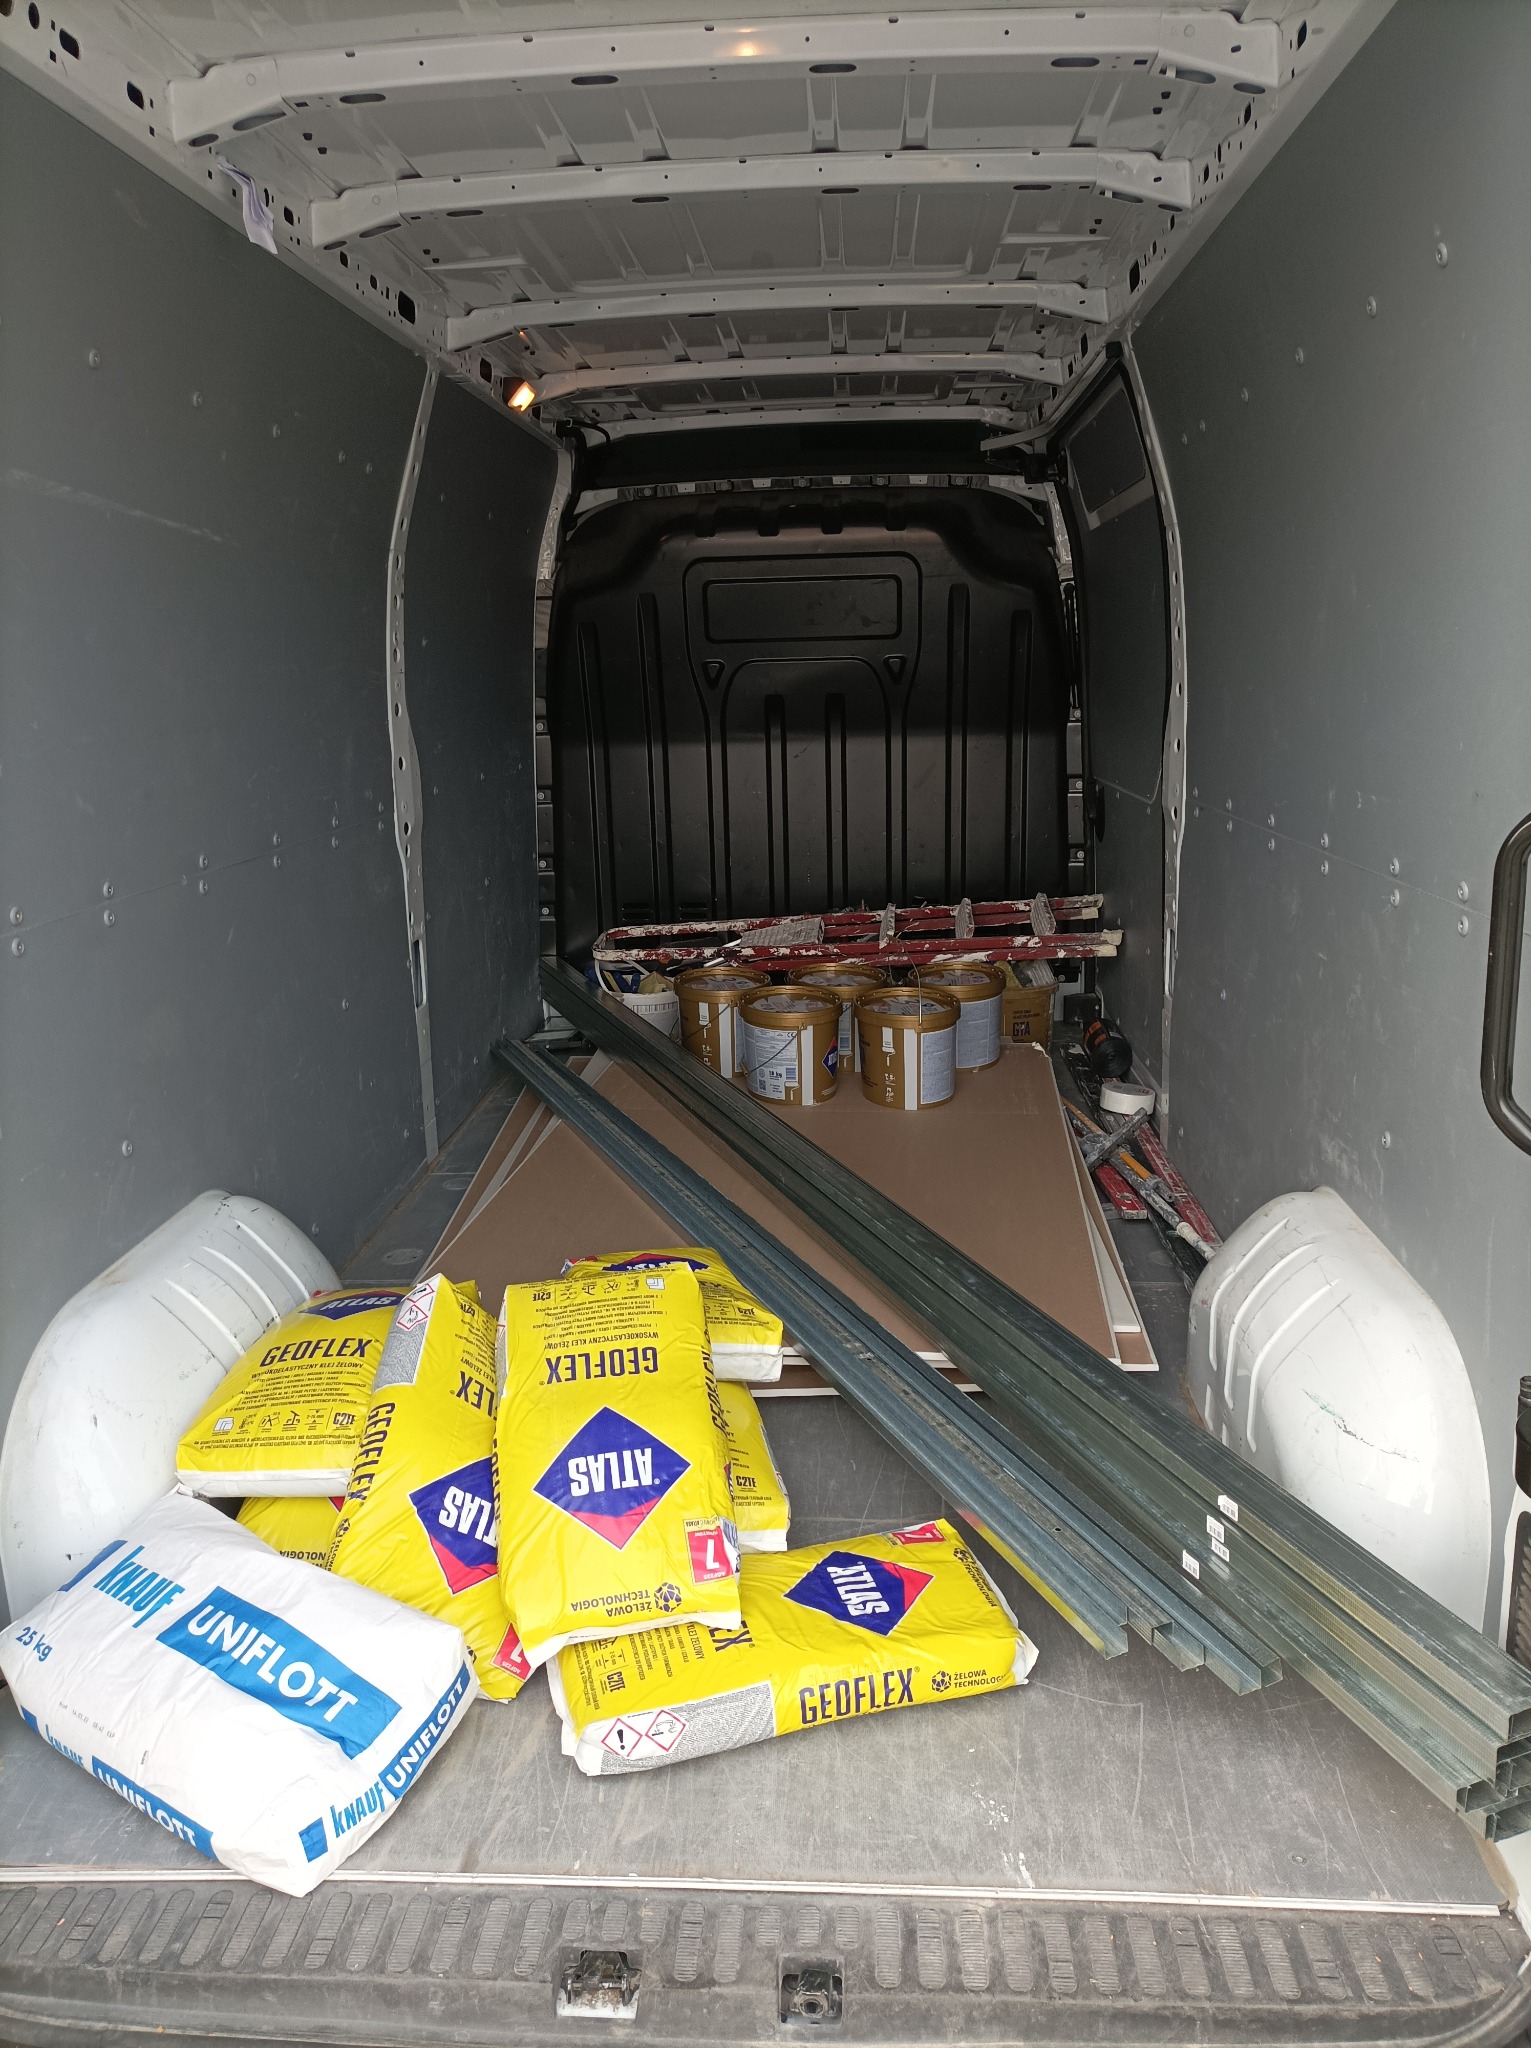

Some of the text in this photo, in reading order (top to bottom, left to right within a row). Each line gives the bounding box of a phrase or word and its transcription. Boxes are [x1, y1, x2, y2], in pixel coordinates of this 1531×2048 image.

[320, 1296, 397, 1311] ATLAS
[260, 1337, 371, 1368] GEOFLEX
[571, 1339, 587, 1347] KLEJ
[588, 1331, 660, 1345] WYSOKOELASTYCZNY
[546, 1346, 659, 1384] GEOFLEX
[347, 1402, 396, 1501] GEOFLEX
[568, 1447, 652, 1497] ATLAS
[736, 1475, 757, 1488] C2TE
[438, 1486, 498, 1548] TLAS
[279, 1550, 327, 1561] NOLOGIA
[94, 1546, 186, 1628] KNAUF
[570, 1589, 651, 1612] TECHNOLOGIA
[826, 1564, 890, 1616] ATLAS
[606, 1602, 652, 1618] ŻELOWA
[16, 1626, 53, 1662] 25 kg
[689, 1637, 706, 1660] ŻELOWY
[187, 1604, 360, 1722] UNIFLOTT
[954, 1669, 988, 1681] ŻELOWA
[606, 1670, 626, 1693] C2TE
[799, 1667, 914, 1724] GEOFLEX
[386, 1676, 465, 1789] UNIFLOTT
[330, 1780, 386, 1839] KNAUF
